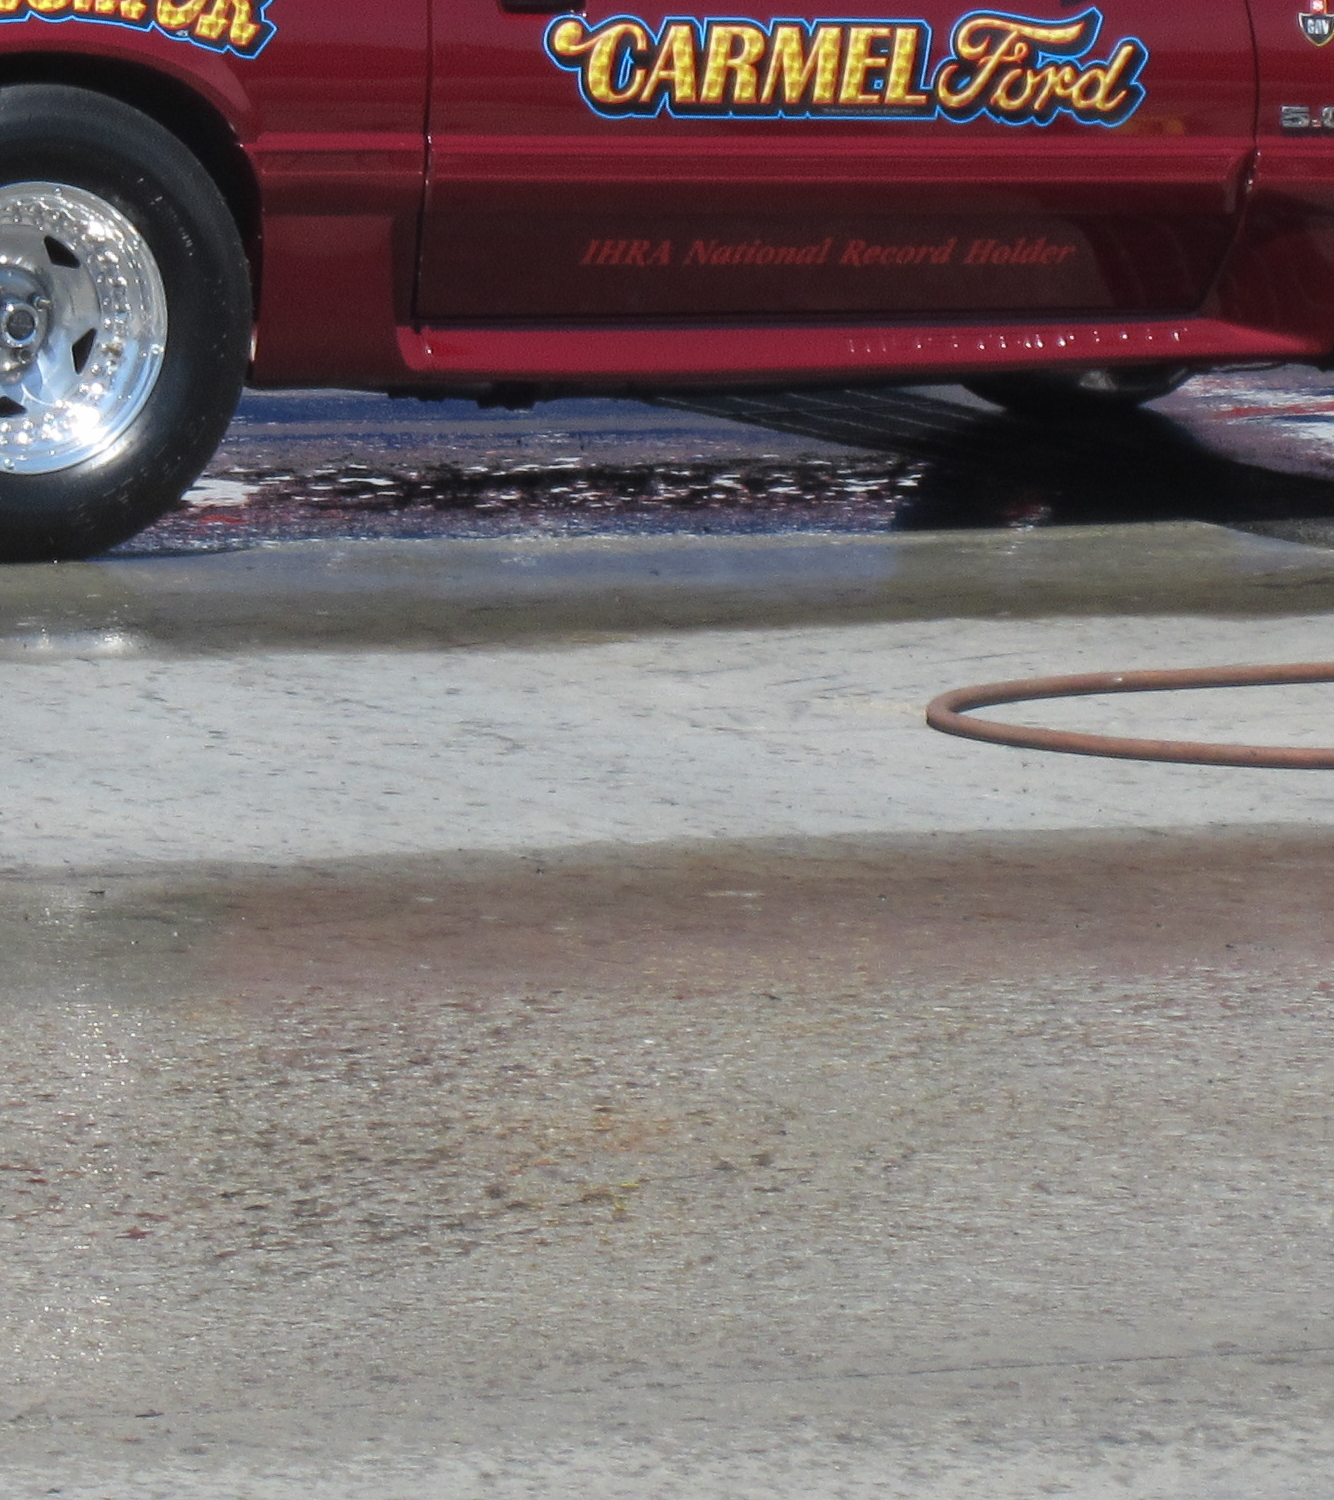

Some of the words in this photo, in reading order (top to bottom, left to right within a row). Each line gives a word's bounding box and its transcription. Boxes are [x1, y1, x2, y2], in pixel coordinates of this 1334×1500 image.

[552, 18, 930, 104] CARMEL
[935, 15, 1137, 112] Ford
[579, 238, 671, 266] IHRA
[683, 237, 834, 266] National
[838, 237, 959, 267] Record
[963, 237, 1076, 266] Holder
